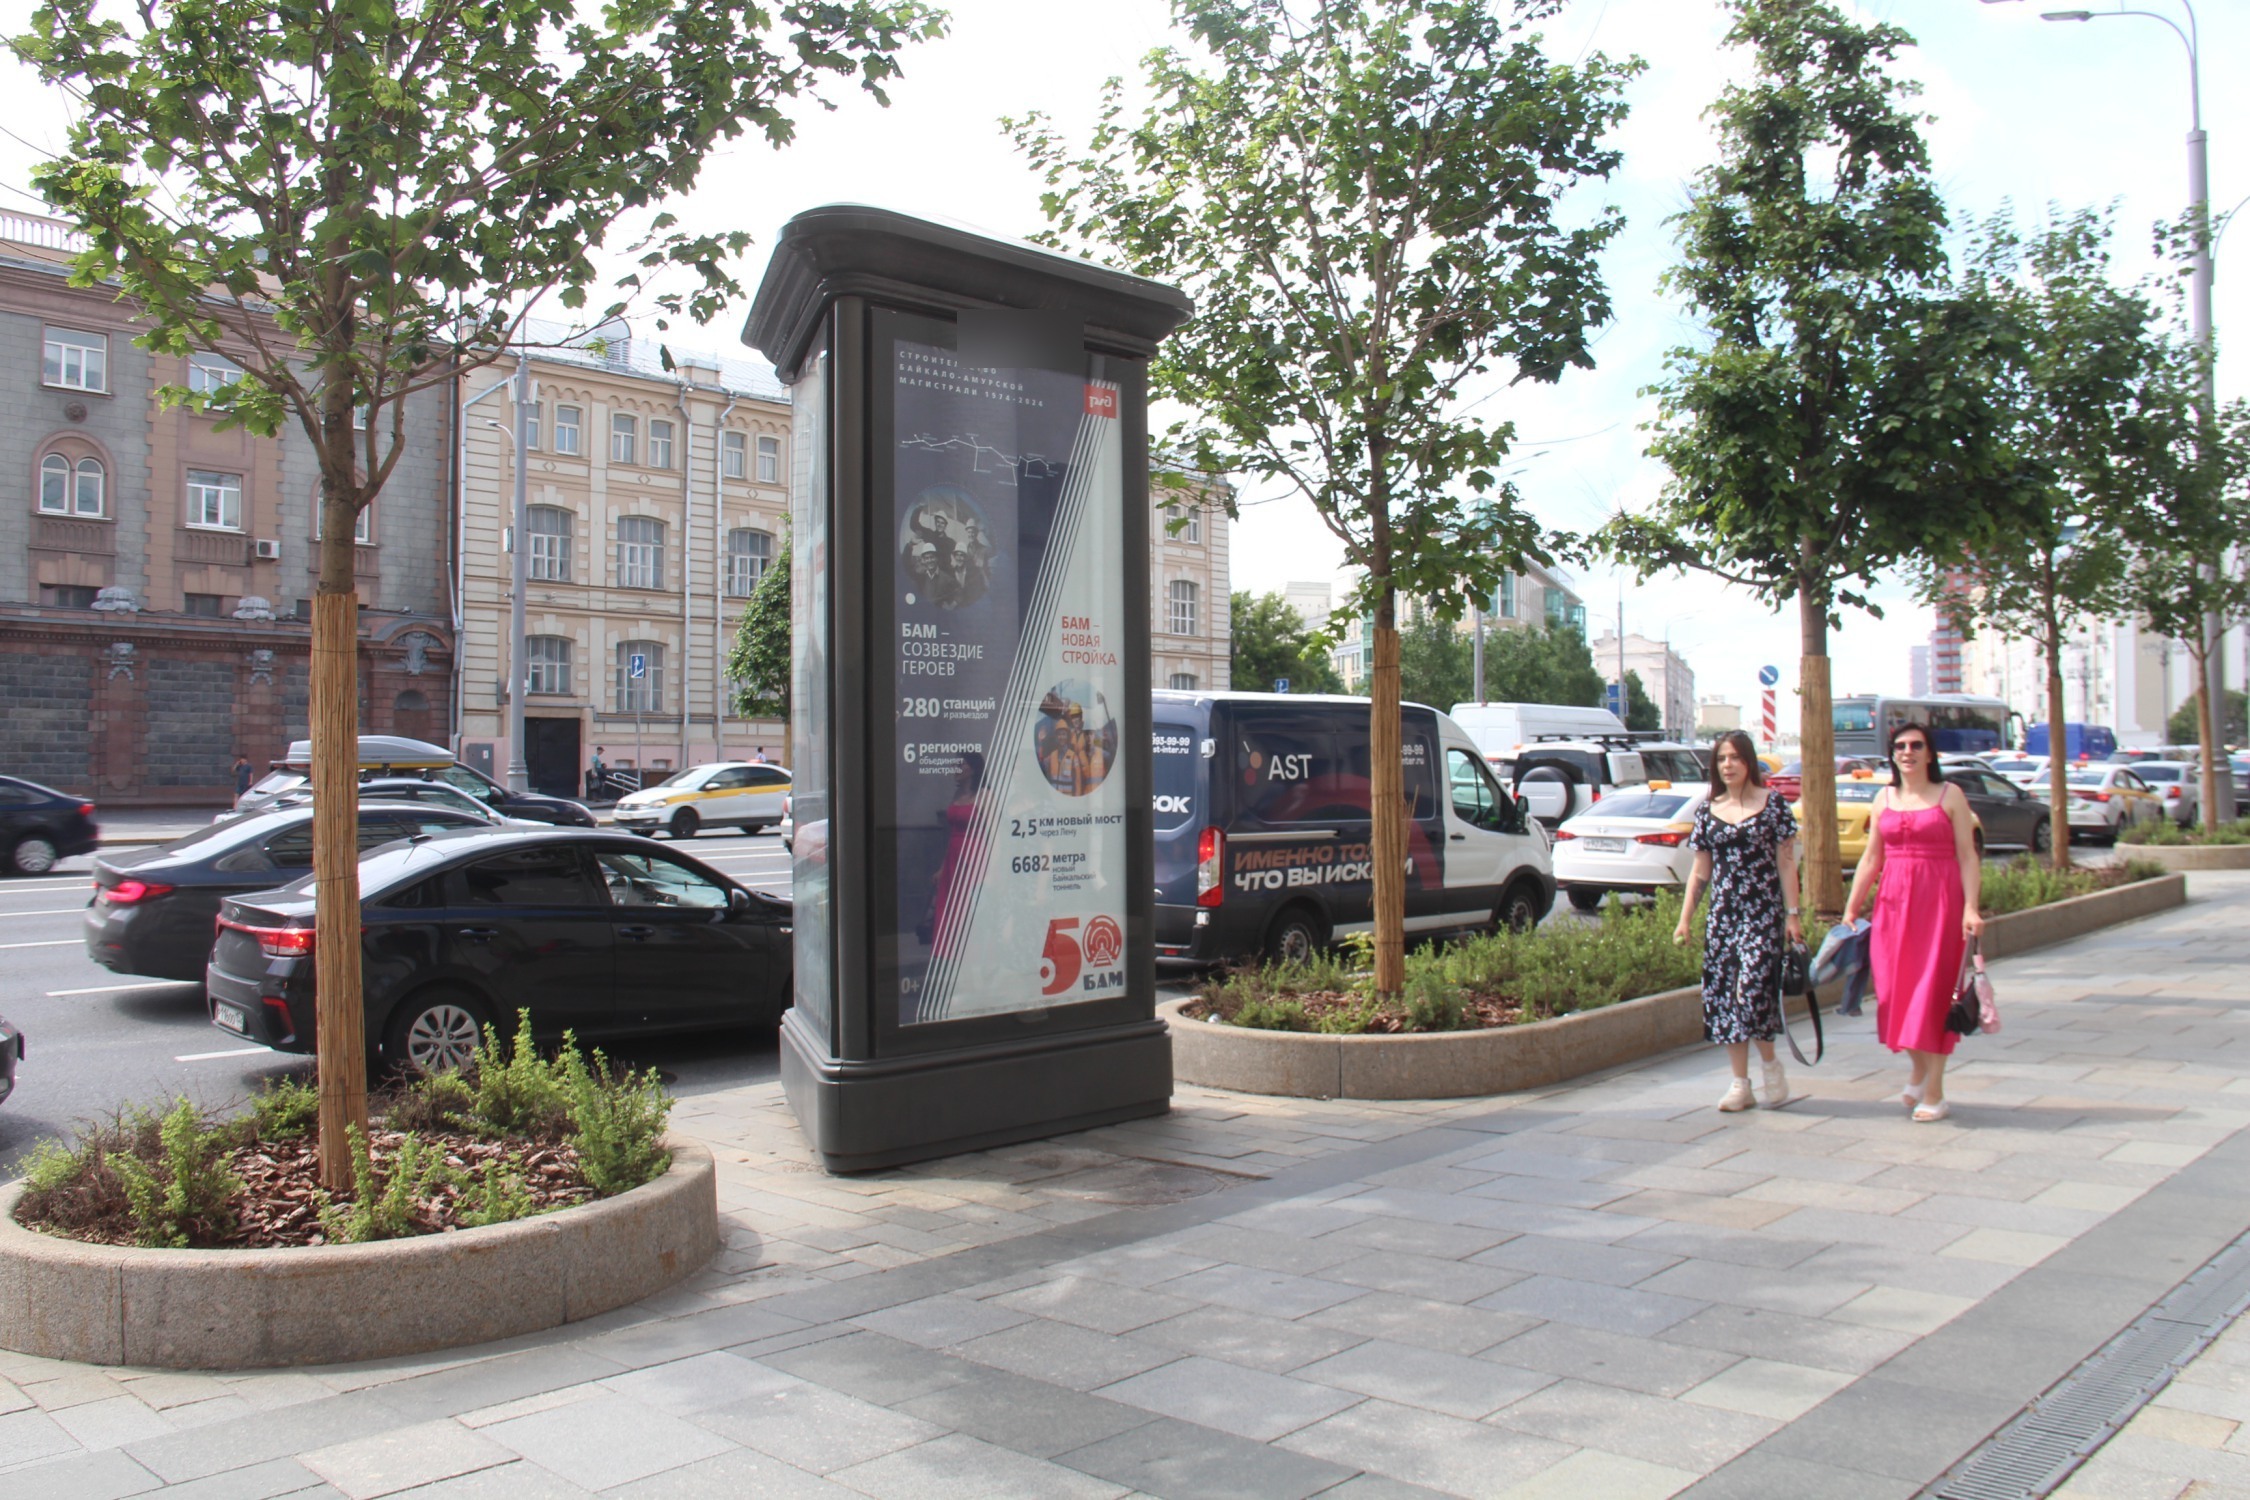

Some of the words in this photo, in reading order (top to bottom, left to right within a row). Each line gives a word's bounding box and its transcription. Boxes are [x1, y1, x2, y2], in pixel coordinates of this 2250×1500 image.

[899, 363, 1024, 392] БАЙКАЛО-АМУРСКОЙ
[899, 376, 978, 396] МАГИСТРАЛИ
[985, 391, 1043, 407] 1974-2024
[902, 623, 937, 639] БАМ
[1061, 615, 1090, 631] БАМ
[1061, 633, 1100, 648] НОВАЯ
[902, 641, 984, 661] СОЗВЕЗДИЕ
[1061, 650, 1117, 666] СТРОЙКА
[902, 660, 955, 676] ГЕРОЕВ
[902, 697, 940, 718] 280
[943, 696, 996, 712] станций
[949, 712, 989, 720] разъездов
[903, 743, 916, 763] 6
[919, 743, 982, 757] регионов
[919, 767, 963, 777] магистраль
[1268, 753, 1312, 780] AST
[1011, 818, 1037, 839] 2,5
[1056, 814, 1093, 826] новый
[1095, 815, 1122, 824] мост
[1012, 855, 1050, 873] 6682
[1052, 853, 1086, 865] метра
[1234, 845, 1334, 871] ИМЕННО
[1234, 869, 1284, 892] ЧТО
[1286, 865, 1322, 887] ВЫ
[1325, 857, 1413, 883] ИСКИ
[901, 977, 920, 994] 0+
[1083, 970, 1124, 991] БАМ
